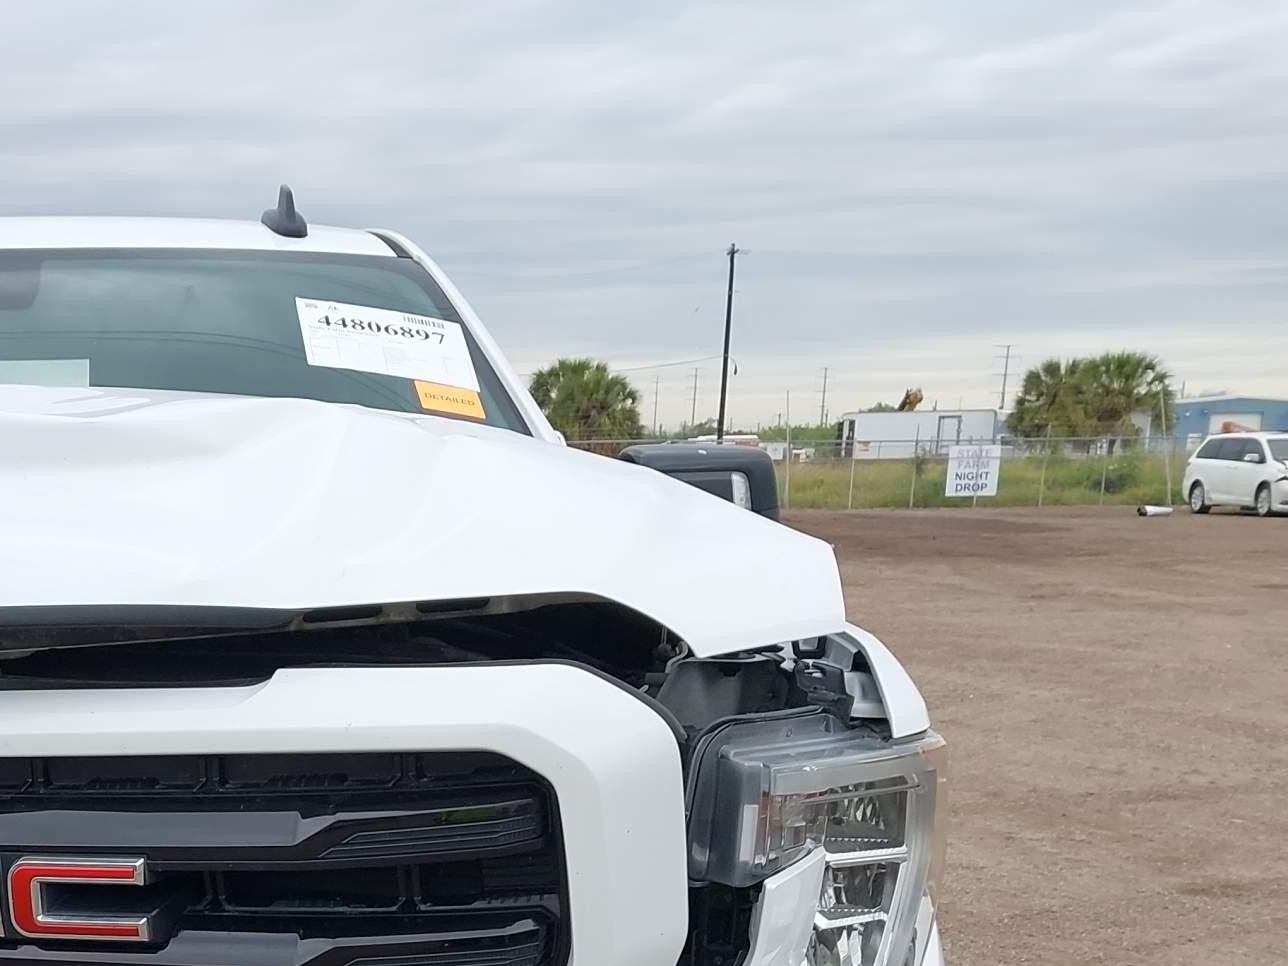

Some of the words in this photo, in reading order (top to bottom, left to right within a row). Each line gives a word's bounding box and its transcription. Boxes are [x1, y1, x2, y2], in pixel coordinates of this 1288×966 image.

[317, 315, 445, 344] 44806897
[423, 392, 476, 406] DETAILED
[954, 471, 990, 481] NIGHT
[954, 482, 988, 492] DROP
